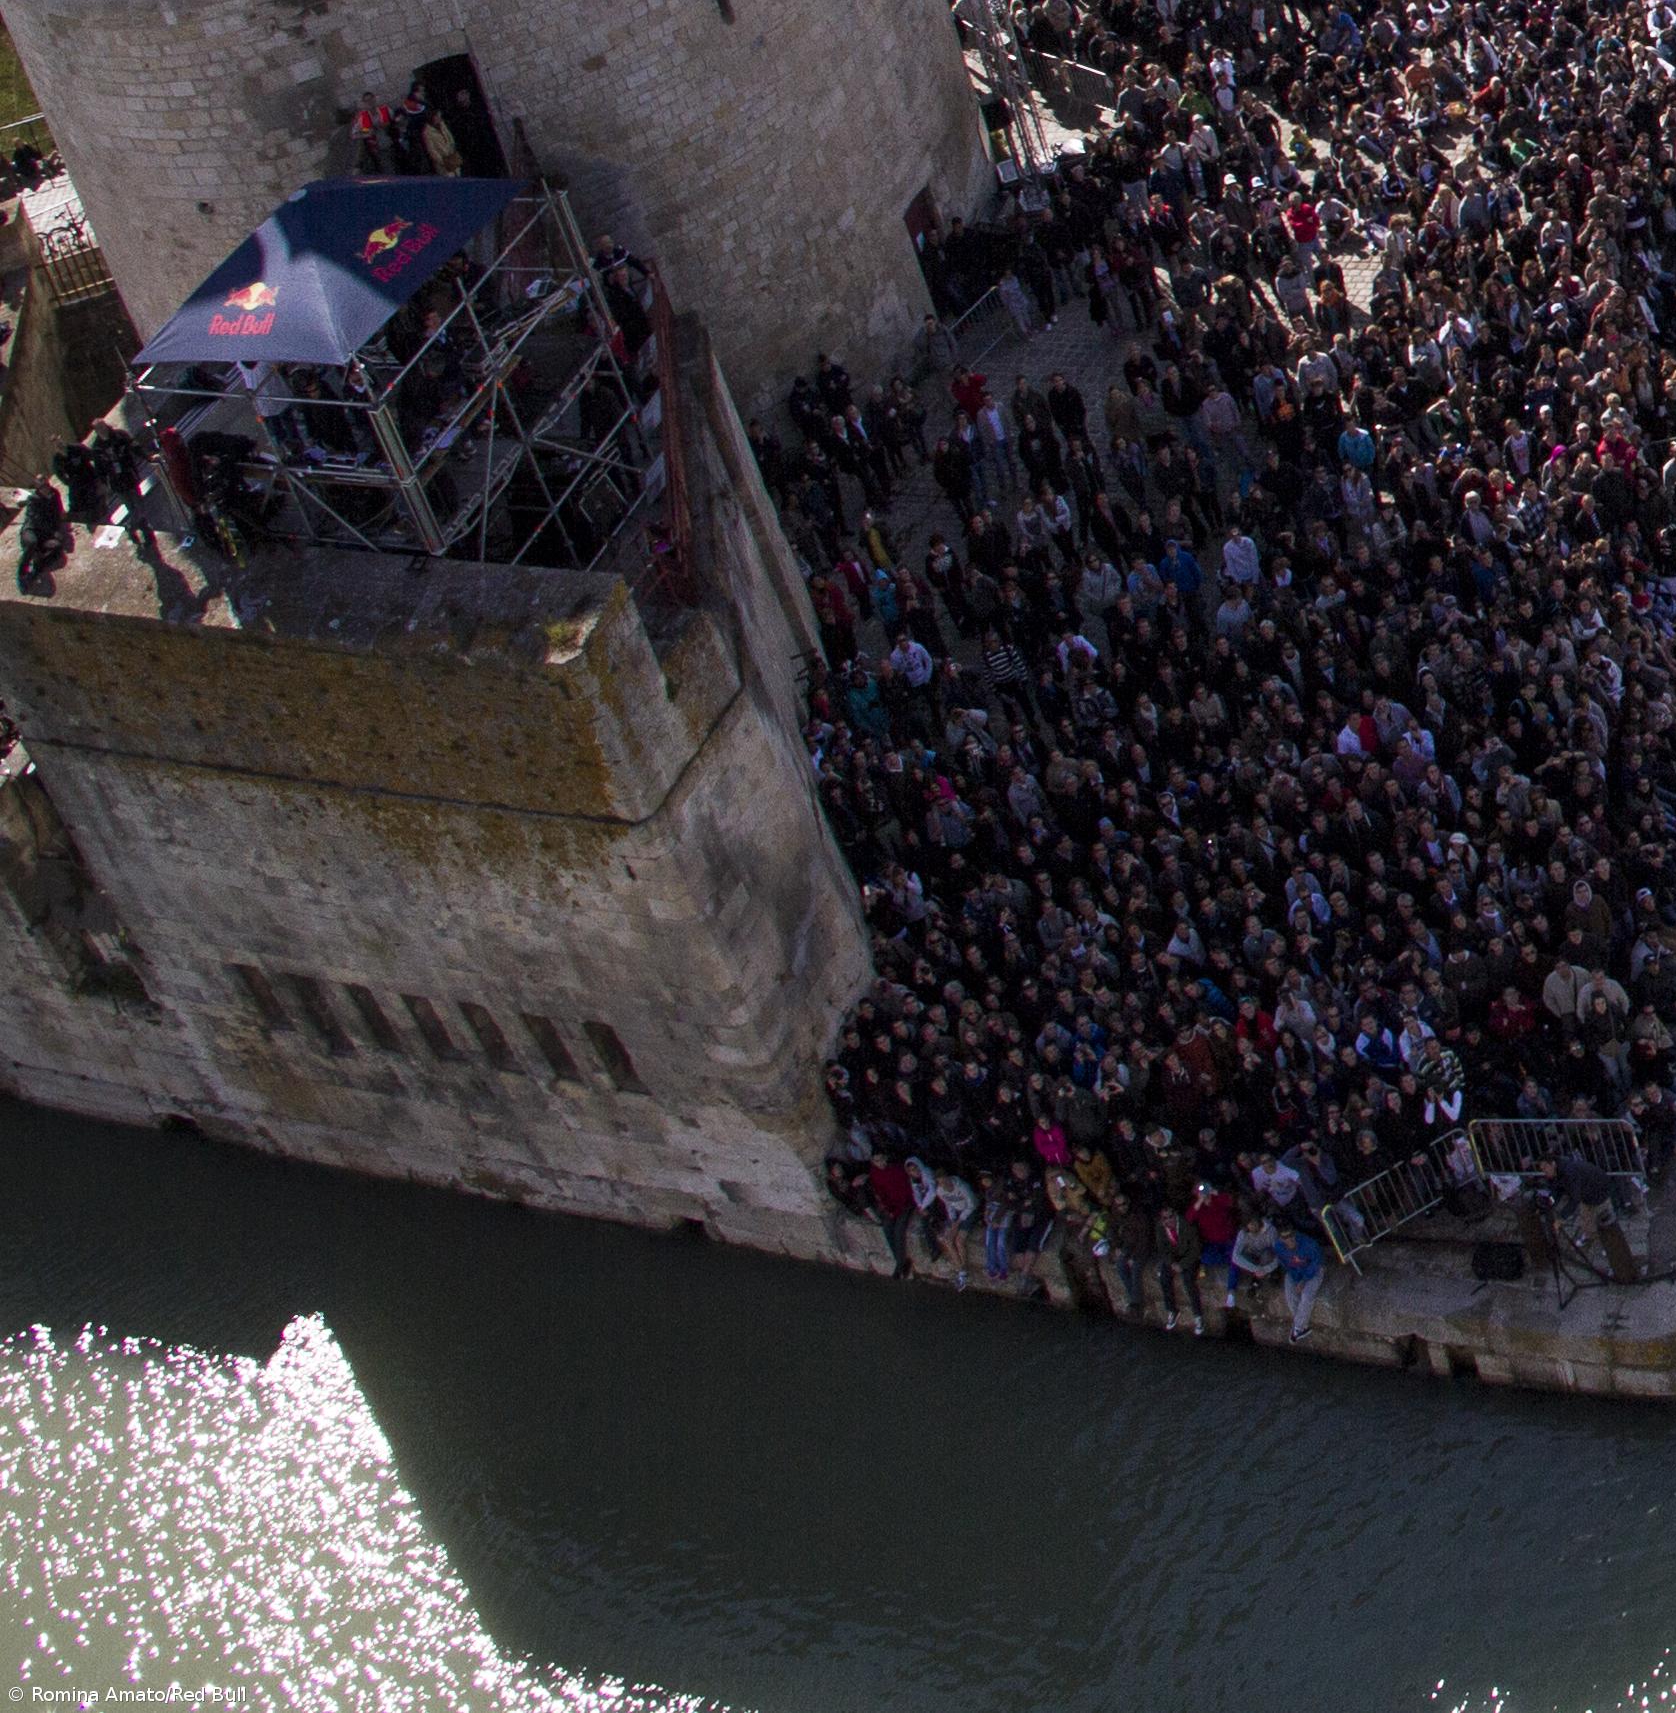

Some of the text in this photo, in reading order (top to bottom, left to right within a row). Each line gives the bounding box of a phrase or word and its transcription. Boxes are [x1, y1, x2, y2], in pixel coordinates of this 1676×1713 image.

[371, 222, 439, 283] Red Bull
[208, 312, 276, 336] Red Bull
